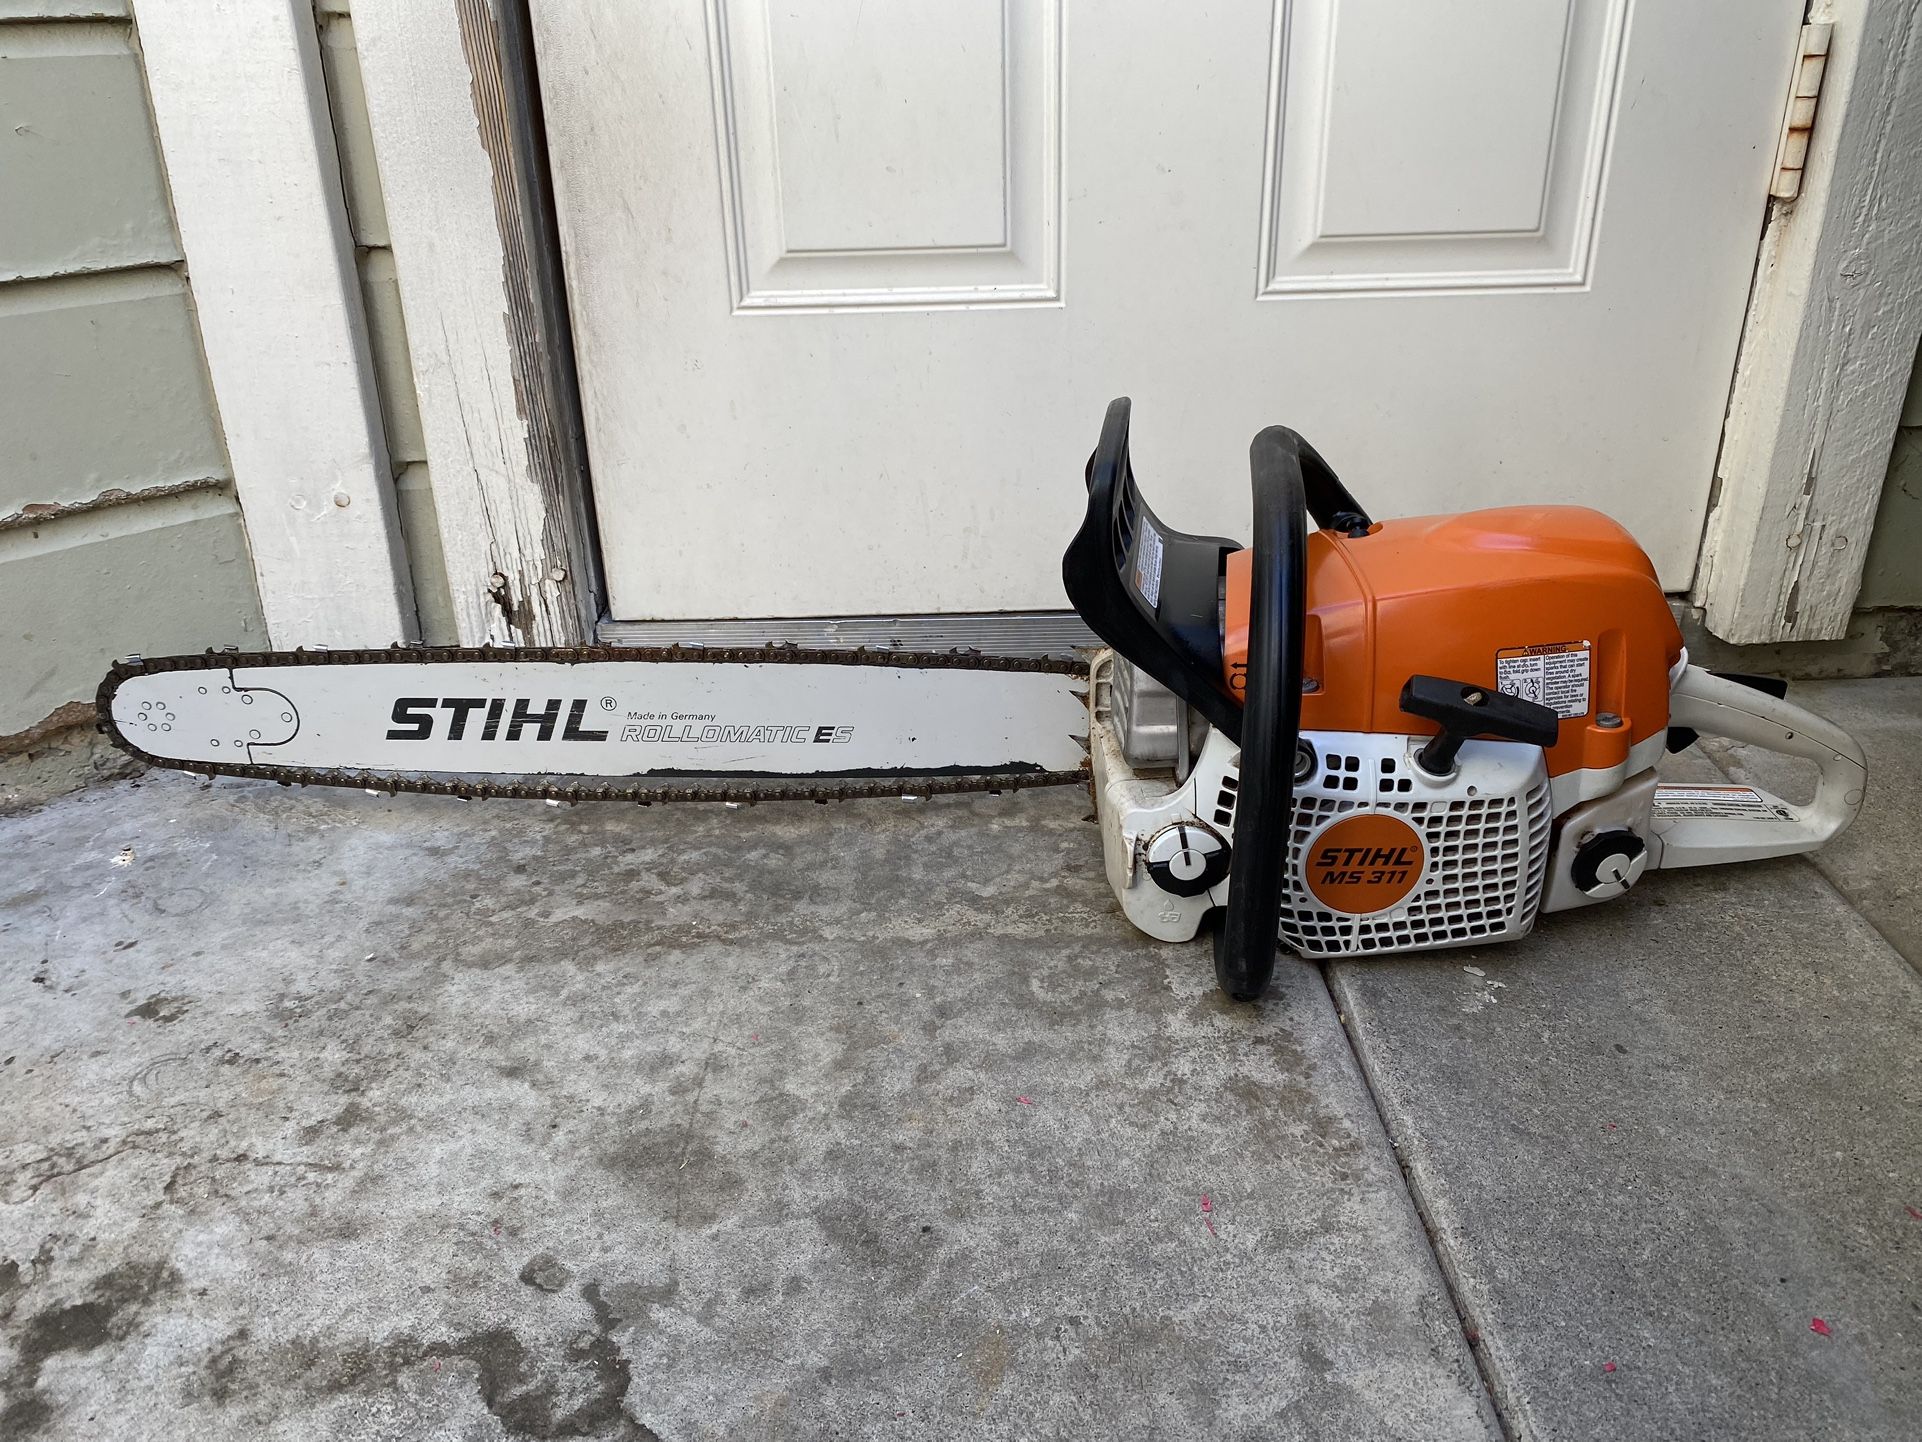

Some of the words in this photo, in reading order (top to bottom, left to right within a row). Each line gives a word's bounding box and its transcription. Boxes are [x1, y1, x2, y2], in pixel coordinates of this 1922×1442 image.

[1529, 646, 1566, 655] WARNING
[386, 698, 609, 741] STIHL
[627, 711, 654, 721] Made
[658, 711, 668, 721] in
[671, 711, 716, 722] Germany
[620, 725, 810, 743] ROLLOMATIC
[813, 726, 855, 743] ES
[1316, 848, 1414, 866] STIHL
[1321, 871, 1365, 885] MS
[1366, 871, 1408, 884] 311
